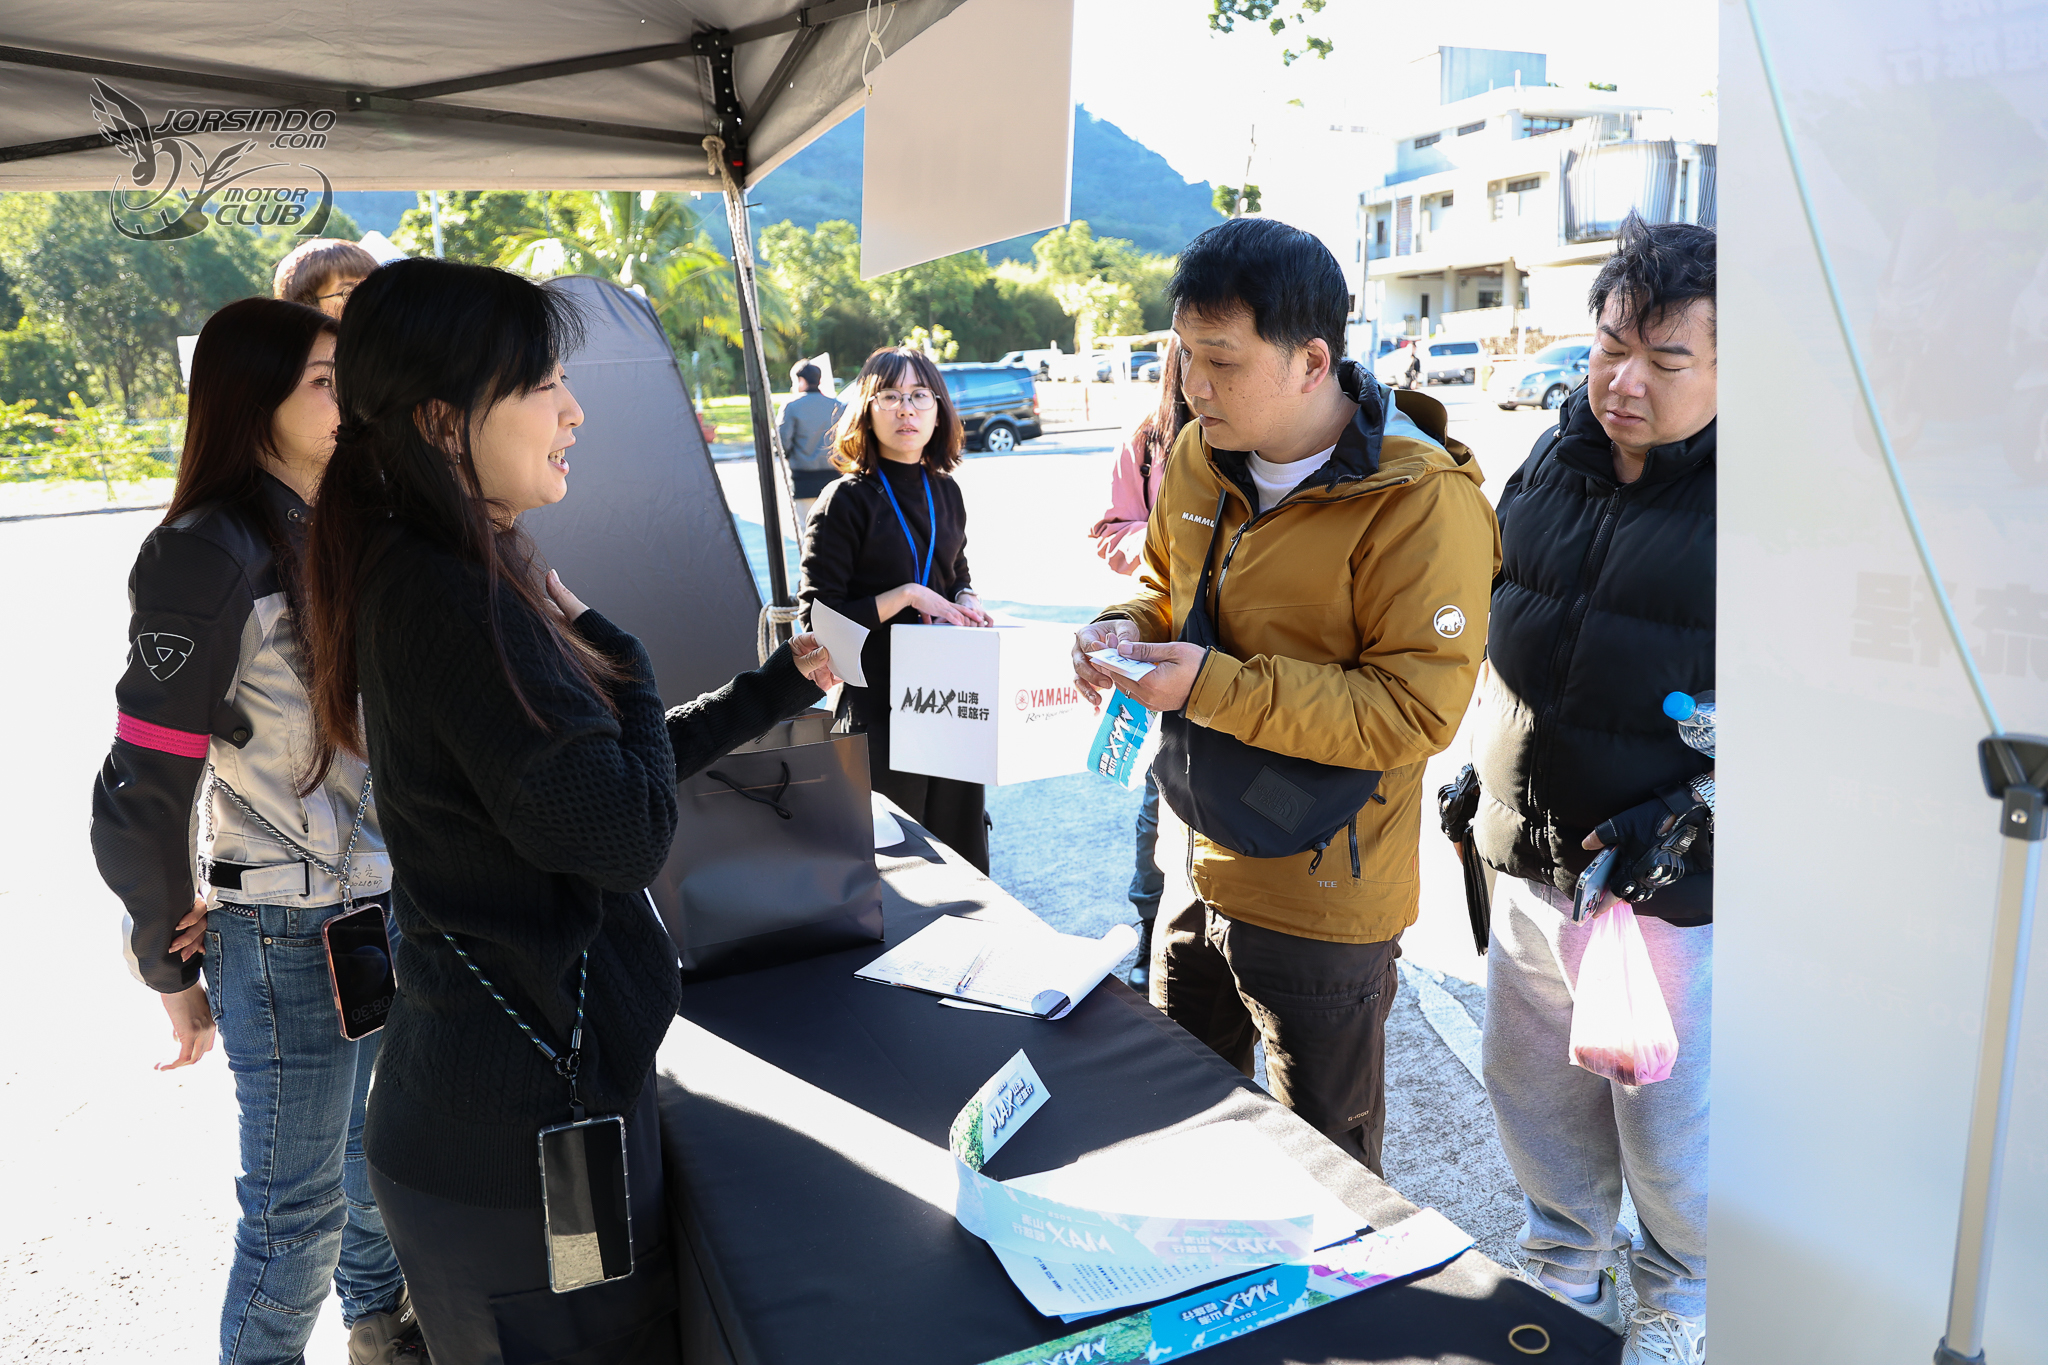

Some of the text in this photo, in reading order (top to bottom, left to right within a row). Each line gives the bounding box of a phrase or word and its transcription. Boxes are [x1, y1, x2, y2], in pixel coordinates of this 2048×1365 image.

[900, 686, 956, 718] MAX
[957, 691, 979, 705] 山海
[1031, 686, 1078, 708] YAMAHA
[957, 706, 990, 721] 輕旅行
[1105, 703, 1134, 759] MAX
[1254, 782, 1287, 808] NORTH
[1258, 794, 1283, 814] FACE
[352, 995, 390, 1022] 08:30
[989, 1088, 1019, 1137] MAX
[1220, 1278, 1279, 1316] MAX
[1198, 1310, 1223, 1326] 山海
[1233, 1310, 1258, 1323] 2025
